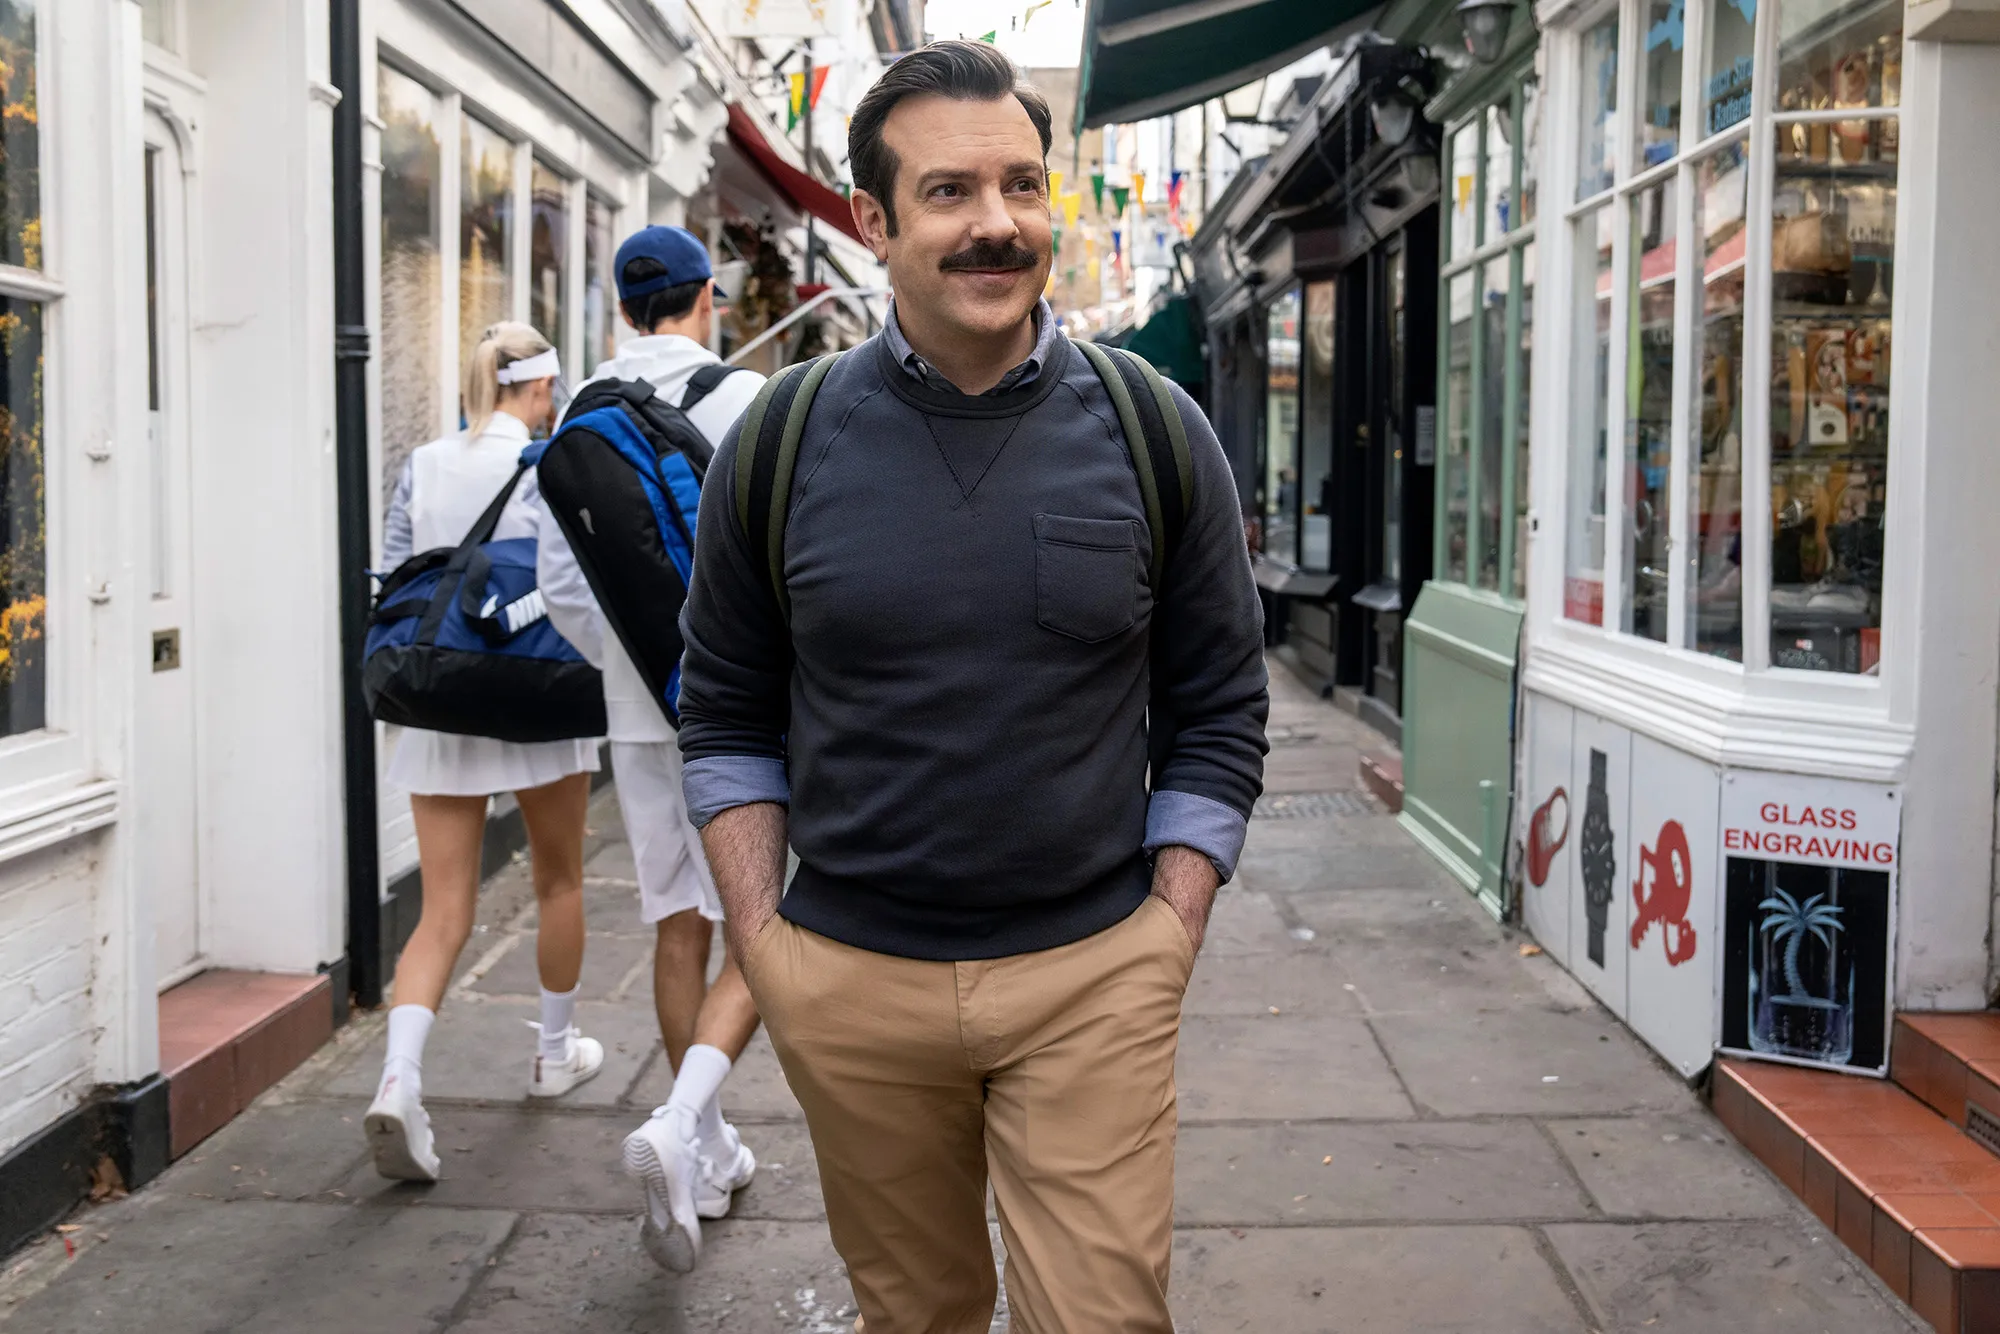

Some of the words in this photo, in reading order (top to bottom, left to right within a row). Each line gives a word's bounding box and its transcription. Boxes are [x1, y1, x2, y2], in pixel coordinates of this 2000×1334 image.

[1714, 88, 1751, 133] Batterie
[504, 588, 547, 633] NIK
[1760, 802, 1857, 830] GLASS
[1724, 828, 1893, 864] ENGRAVING
